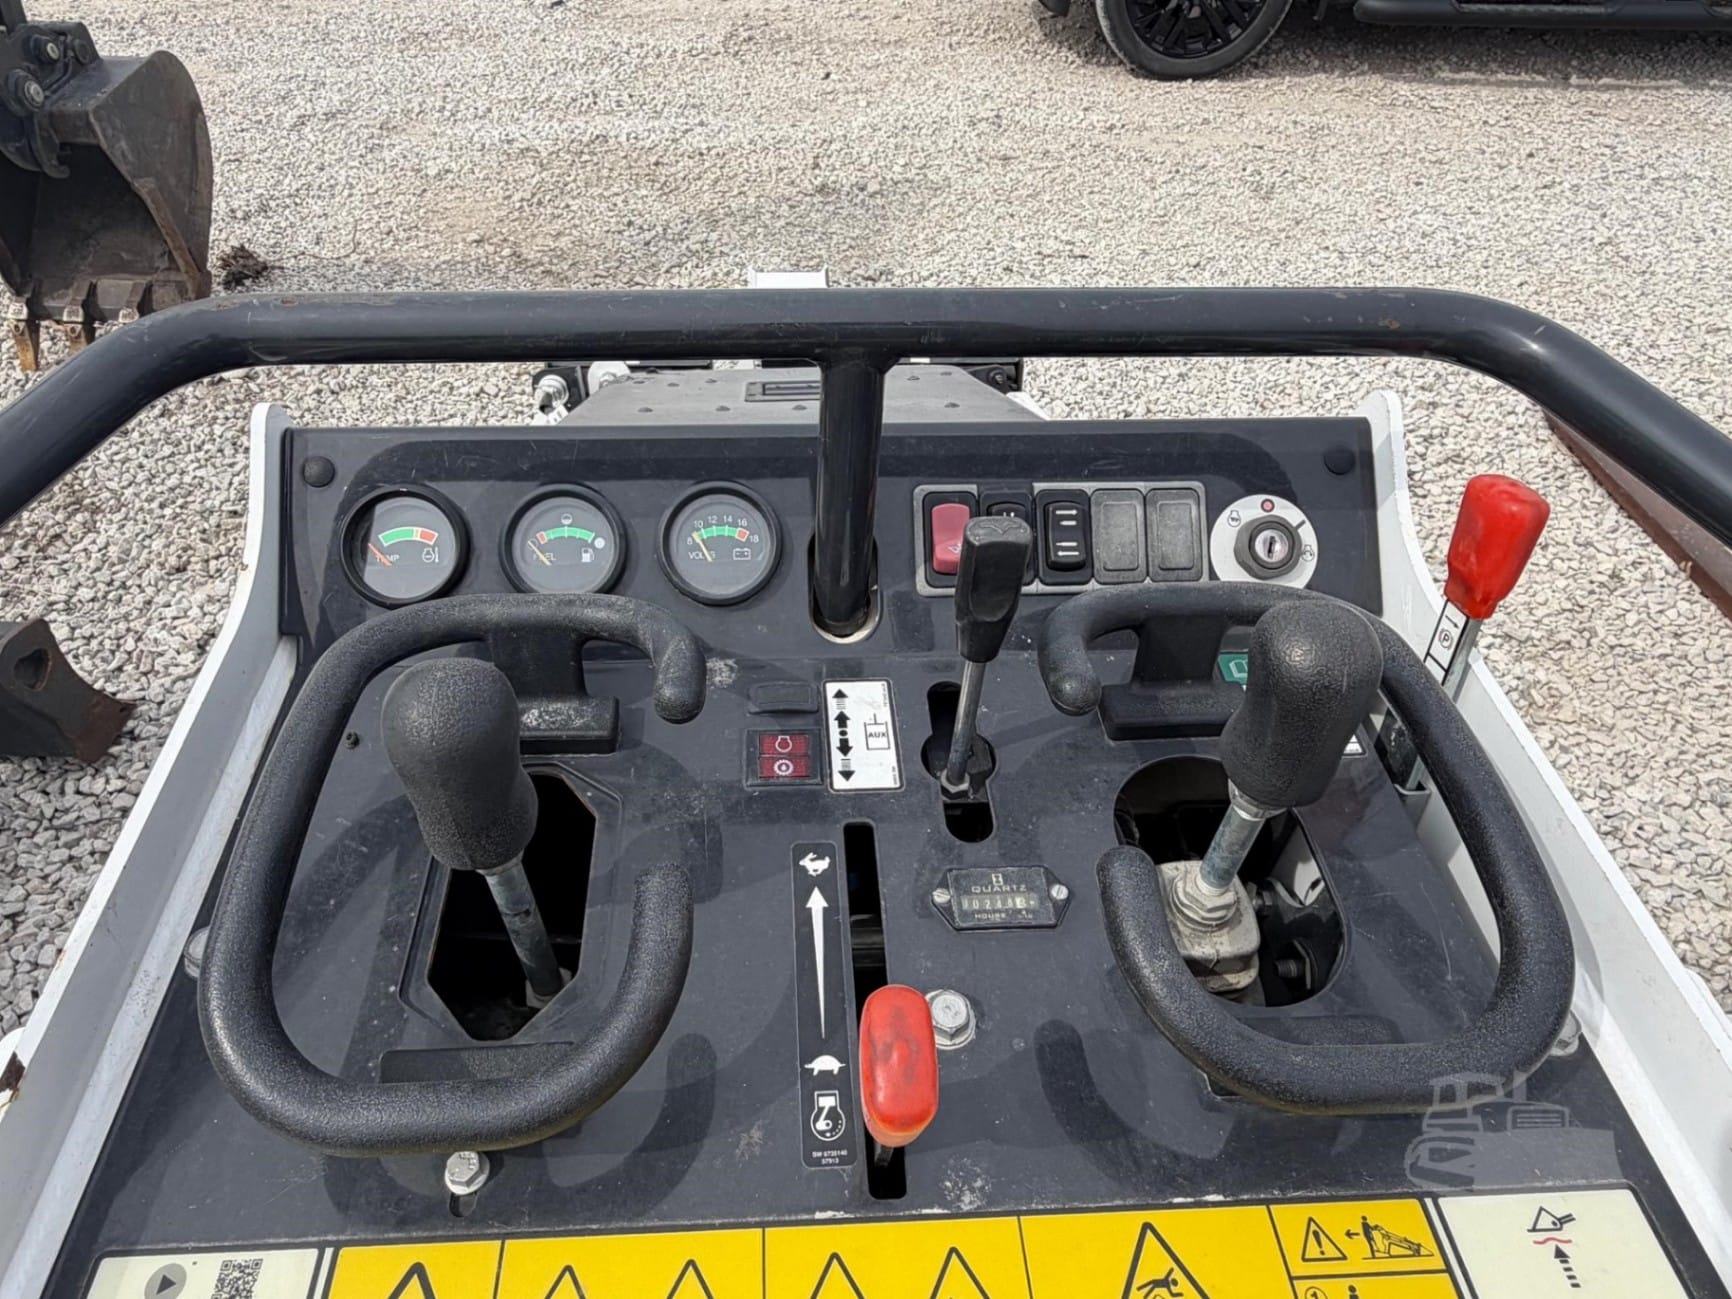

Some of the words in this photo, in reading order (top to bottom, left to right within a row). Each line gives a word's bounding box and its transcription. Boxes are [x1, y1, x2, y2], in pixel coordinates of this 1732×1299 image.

[707, 514, 718, 525] 12
[723, 514, 733, 524] 14
[737, 517, 748, 527] 16
[749, 533, 760, 544] 18
[375, 553, 401, 564] TMP
[532, 551, 557, 562] FEL
[687, 550, 716, 561] VOLS
[867, 730, 888, 739] AUX
[970, 883, 1028, 894] QUARTZ
